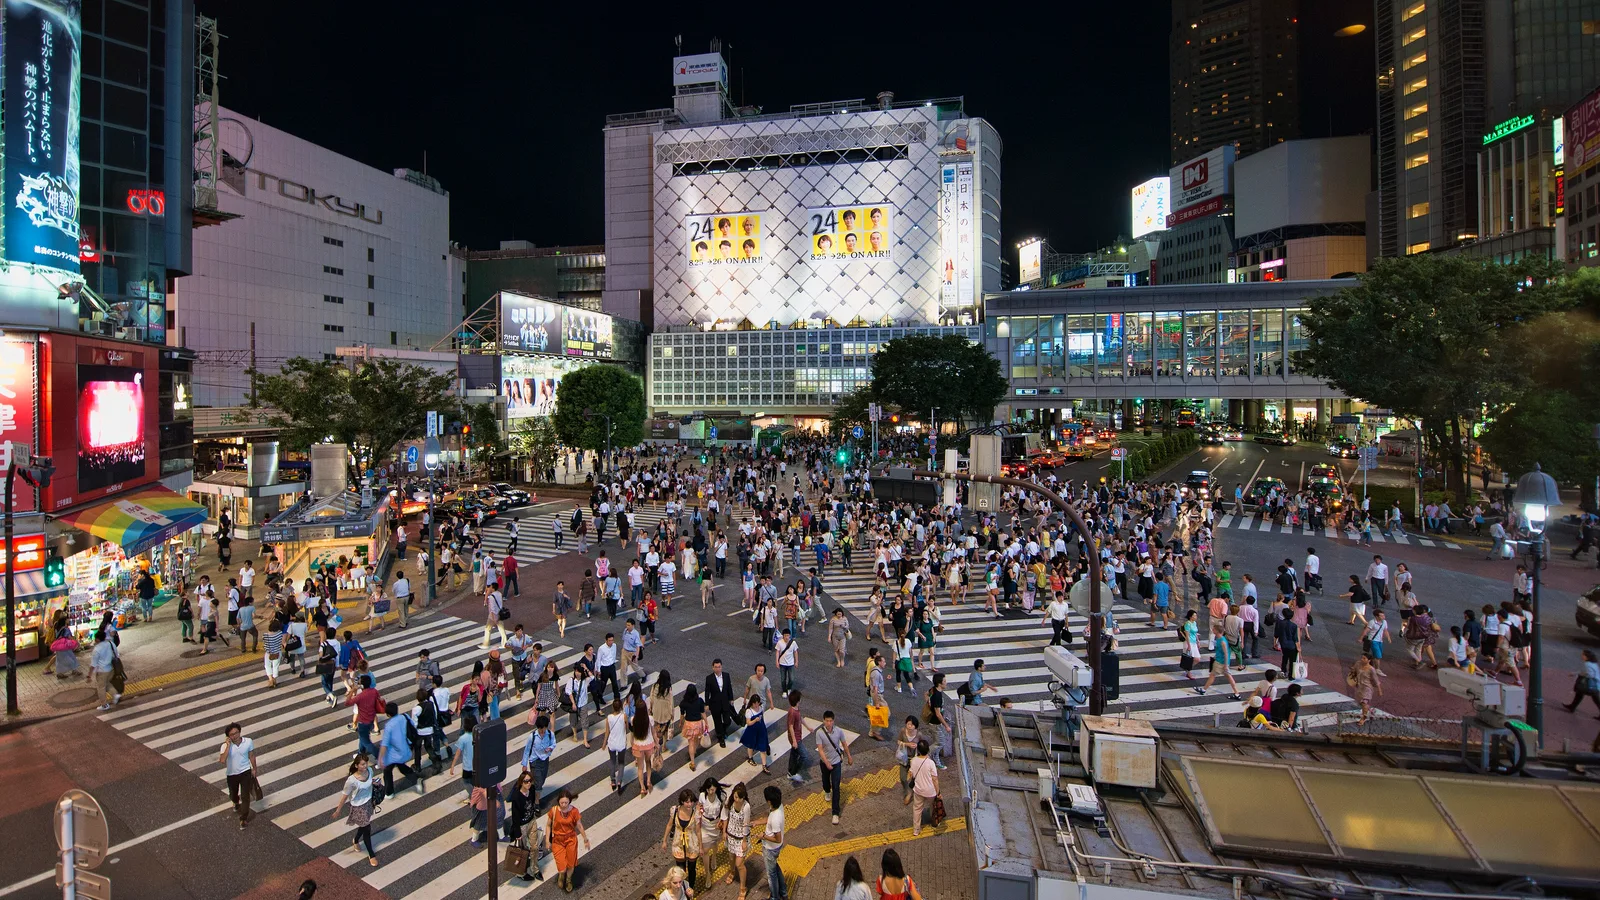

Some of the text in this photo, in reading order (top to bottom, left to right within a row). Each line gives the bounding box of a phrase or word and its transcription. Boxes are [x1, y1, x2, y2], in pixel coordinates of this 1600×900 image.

[41, 19, 53, 159] 進化がもう、止まらない。
[24, 61, 38, 163] 神撃のバハムート。
[1494, 115, 1520, 131] SHIBUYA
[1483, 114, 1534, 143] MARK CITY
[246, 168, 383, 225] TOKYU
[690, 216, 715, 242] 24
[811, 209, 839, 236] 24
[220, 412, 270, 425] 渋谷
